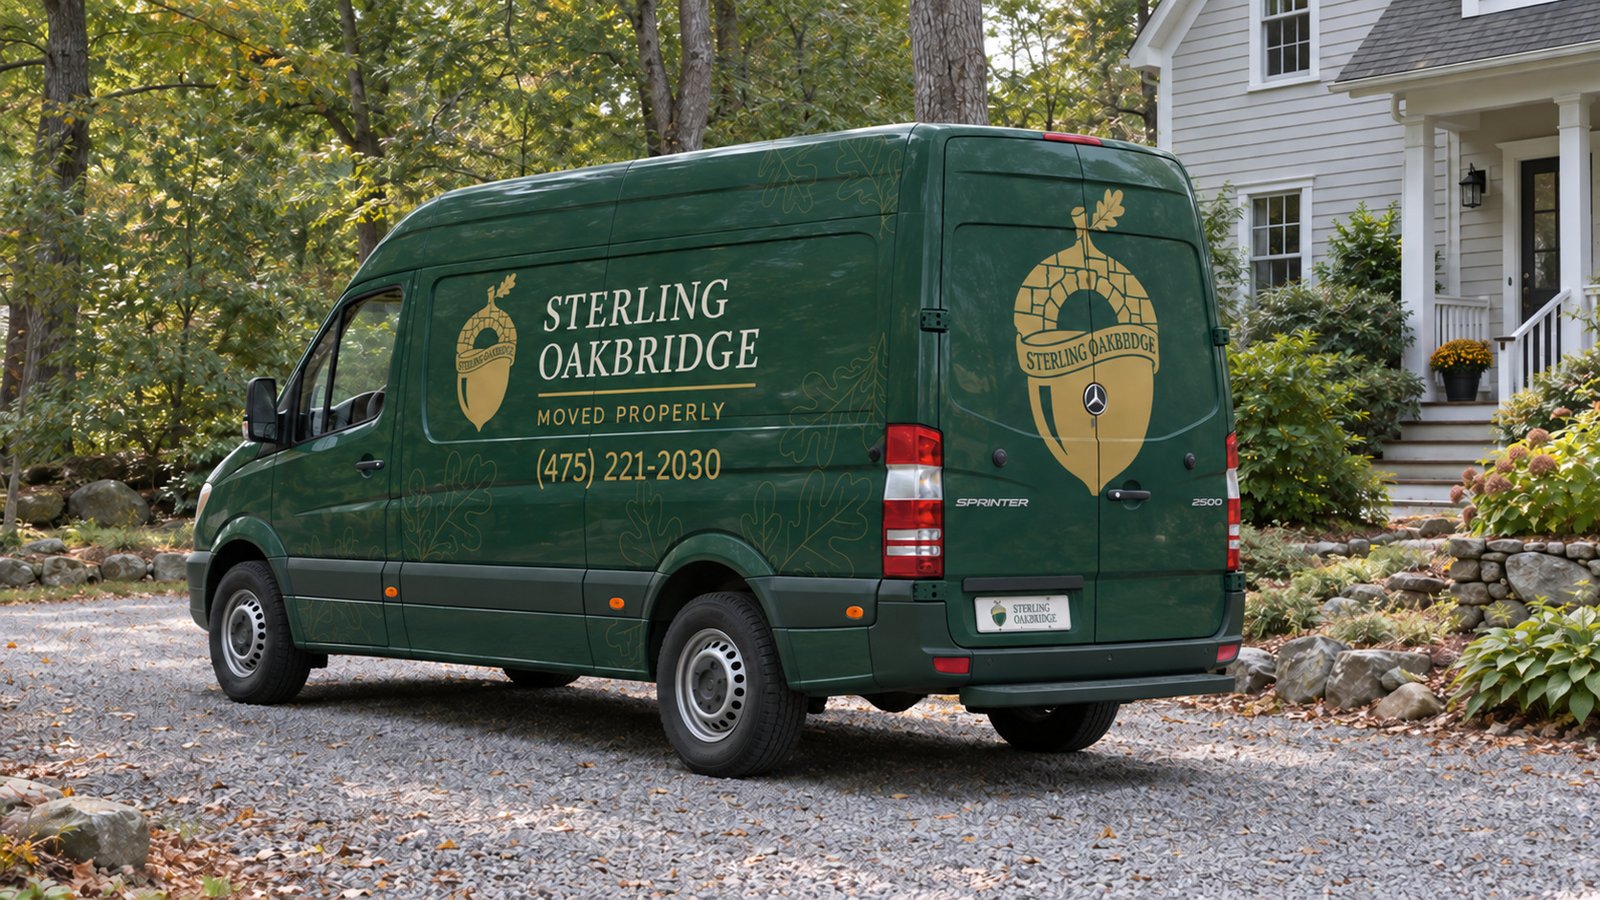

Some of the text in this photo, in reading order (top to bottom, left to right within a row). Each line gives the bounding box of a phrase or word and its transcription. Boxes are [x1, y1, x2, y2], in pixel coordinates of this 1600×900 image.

[543, 278, 729, 332] STERLING
[538, 328, 760, 381] OAKBRIDGE
[1026, 342, 1088, 370] STERLING
[537, 402, 725, 426] MOVED PROPERLY
[536, 448, 721, 490] (475) 221-2030
[955, 498, 1029, 507] SPRINTER
[1191, 498, 1223, 506] 2500
[1013, 603, 1050, 613] STERLING
